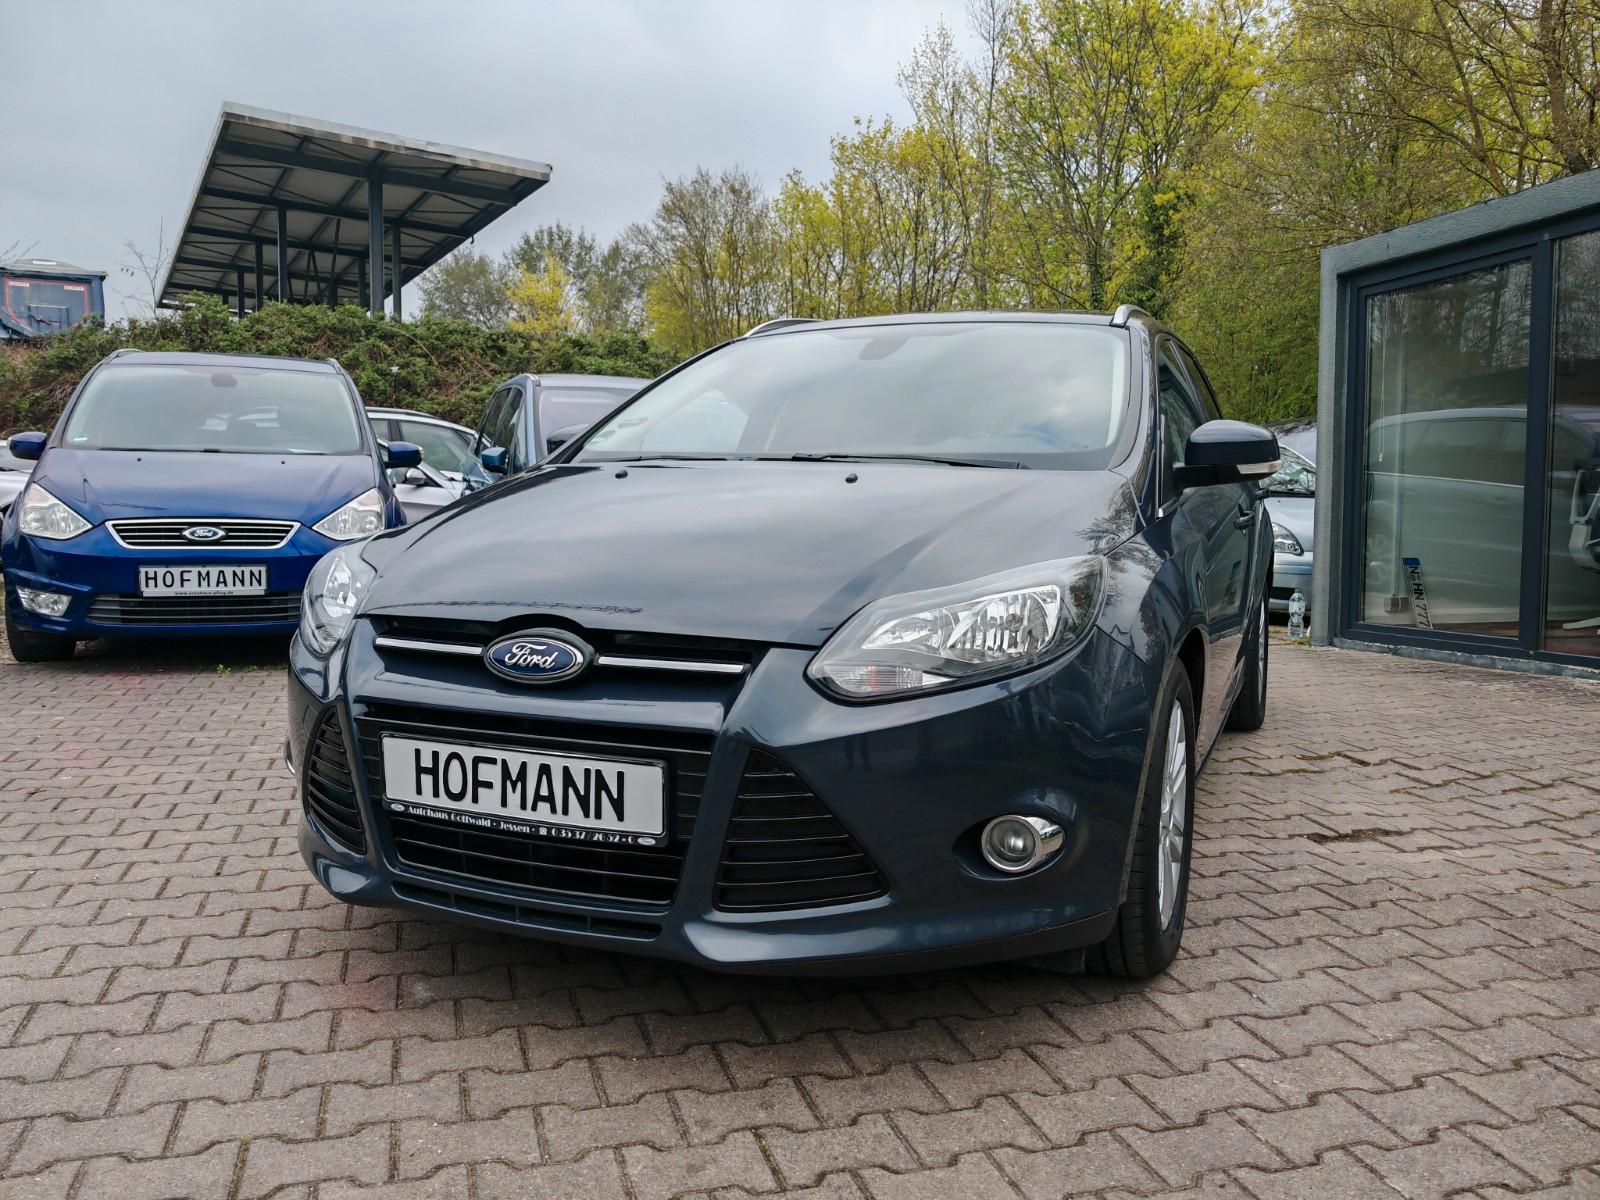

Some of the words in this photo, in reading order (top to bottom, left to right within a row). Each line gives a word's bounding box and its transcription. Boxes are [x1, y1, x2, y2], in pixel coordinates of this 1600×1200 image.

[144, 569, 262, 588] HOFMANN
[505, 643, 558, 669] Ford
[414, 748, 625, 822] HOFMANN
[407, 805, 449, 820] Autohaus
[450, 812, 491, 828] Gottwald
[499, 822, 530, 834] Jessen
